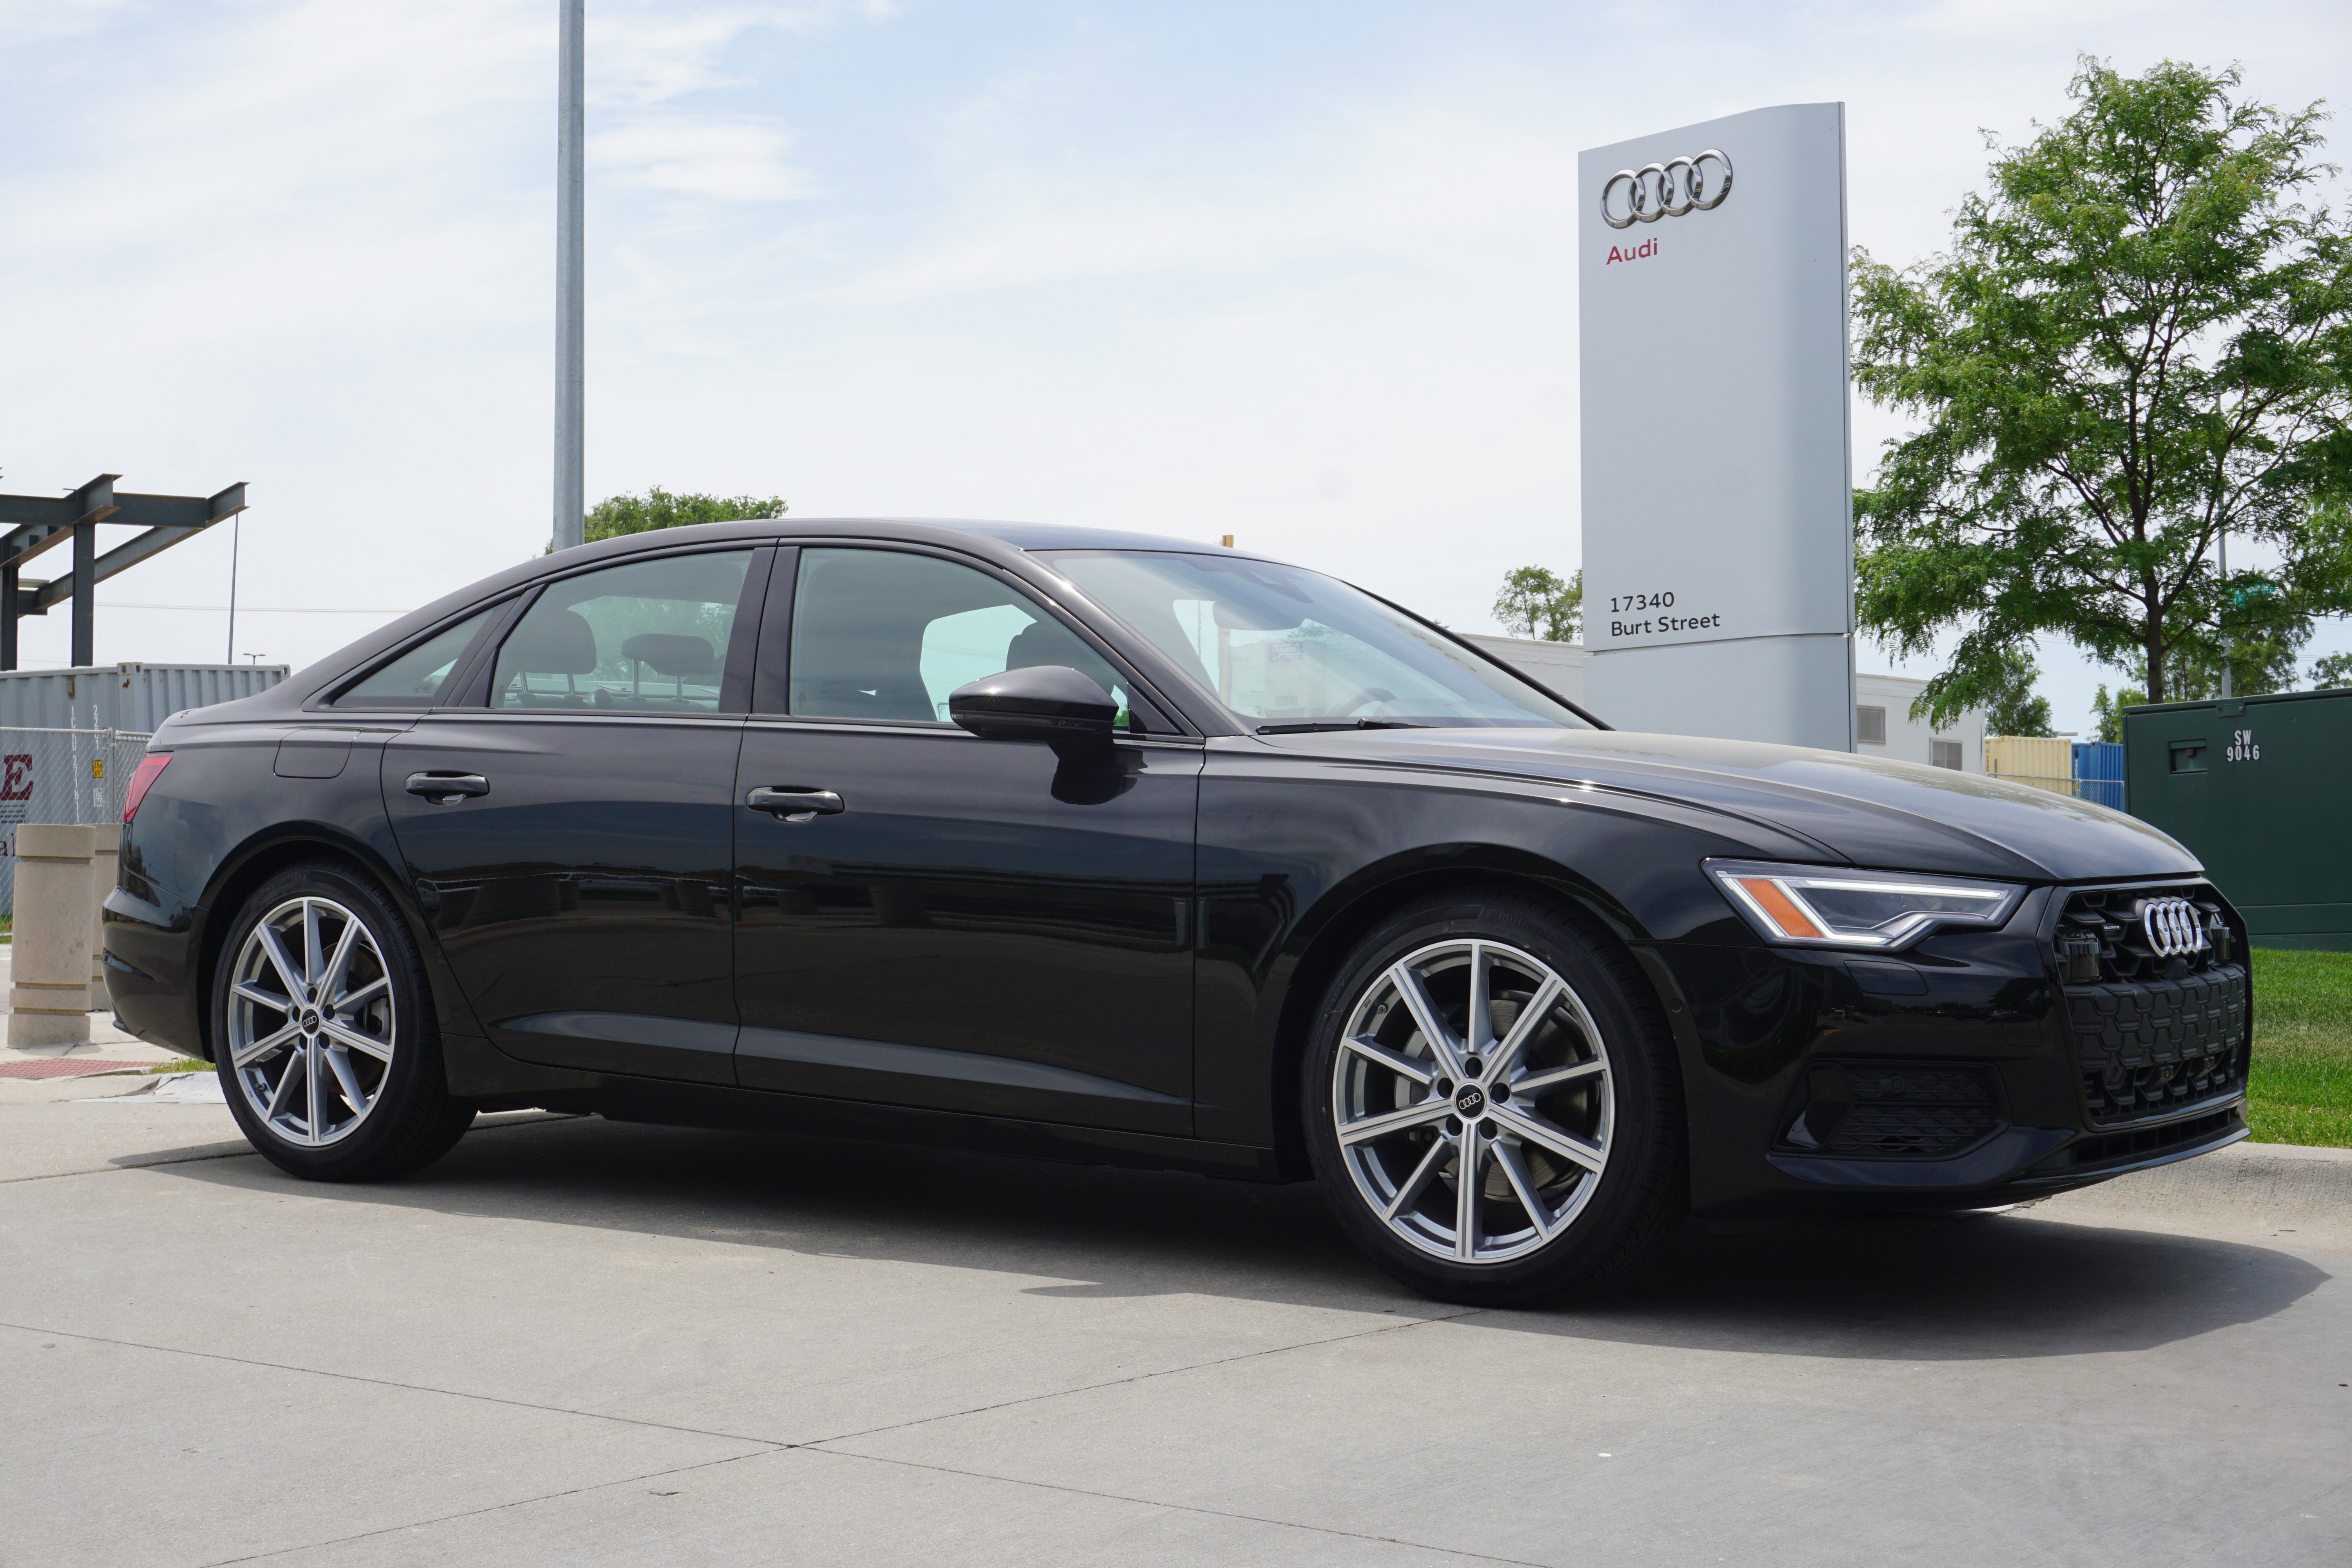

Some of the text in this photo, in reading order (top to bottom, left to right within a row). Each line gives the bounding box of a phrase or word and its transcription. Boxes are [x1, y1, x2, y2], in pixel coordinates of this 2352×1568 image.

[1606, 237, 1658, 265] Audi
[1611, 592, 1674, 612] 17340
[1612, 613, 1720, 636] Burt Street
[2235, 730, 2251, 745] SW
[2227, 745, 2259, 762] 9046
